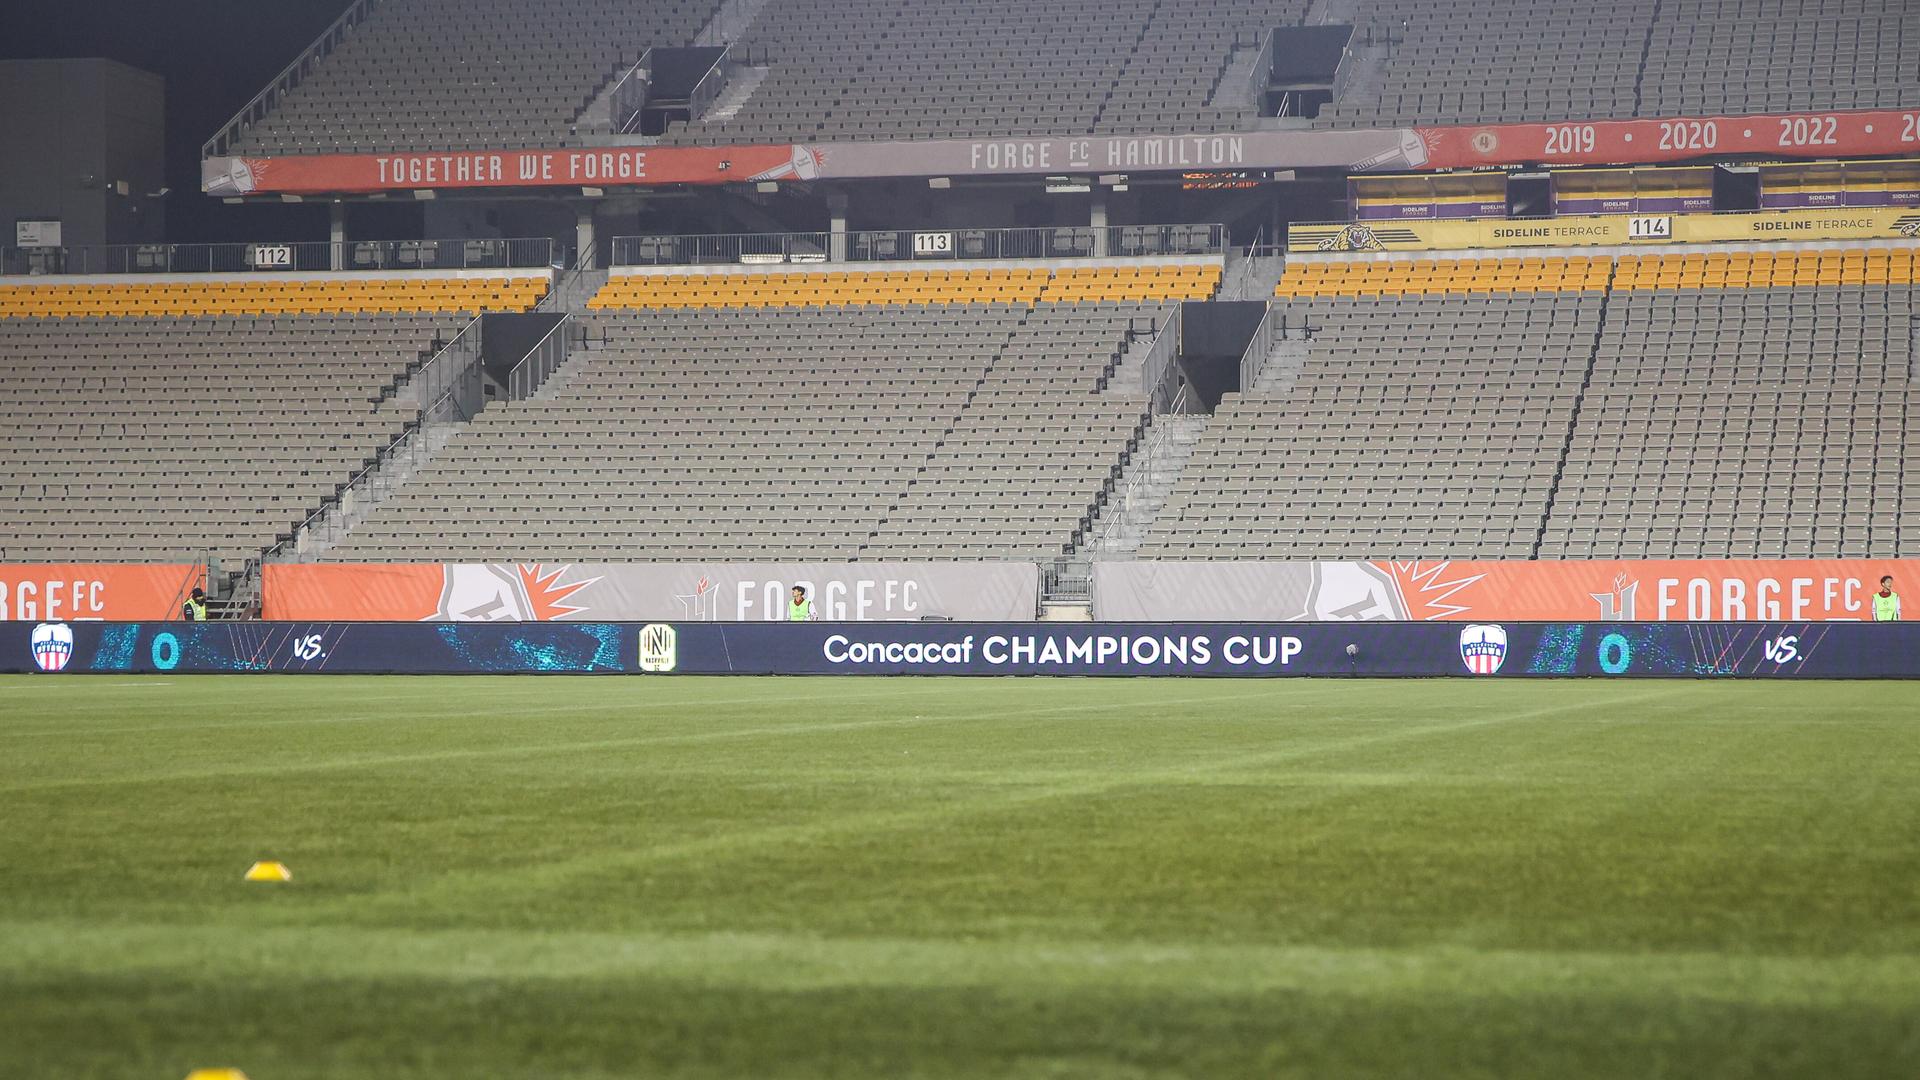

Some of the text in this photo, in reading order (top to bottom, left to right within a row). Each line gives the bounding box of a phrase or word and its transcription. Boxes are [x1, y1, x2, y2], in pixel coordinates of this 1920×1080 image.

[1545, 126, 1595, 154] 2019
[1659, 121, 1717, 150] 2020
[1778, 117, 1837, 146] 2022
[377, 152, 647, 183] TOGETHER WE FORGE
[971, 137, 1243, 169] FORGE FC HAMILTON
[1493, 226, 1609, 239] SIDELINE TERRACE
[1632, 218, 1665, 236] 114
[1753, 219, 1873, 232] SIDELINE TERRACE
[259, 248, 286, 264] 112
[918, 235, 947, 250] 113
[73, 580, 104, 612] FC
[885, 580, 918, 612] FC
[1658, 577, 1861, 621] FORGE FC
[151, 632, 182, 671] 0
[823, 634, 1303, 666] Concacaf CHAMPIONS CUP
[1599, 632, 1633, 674] 0
